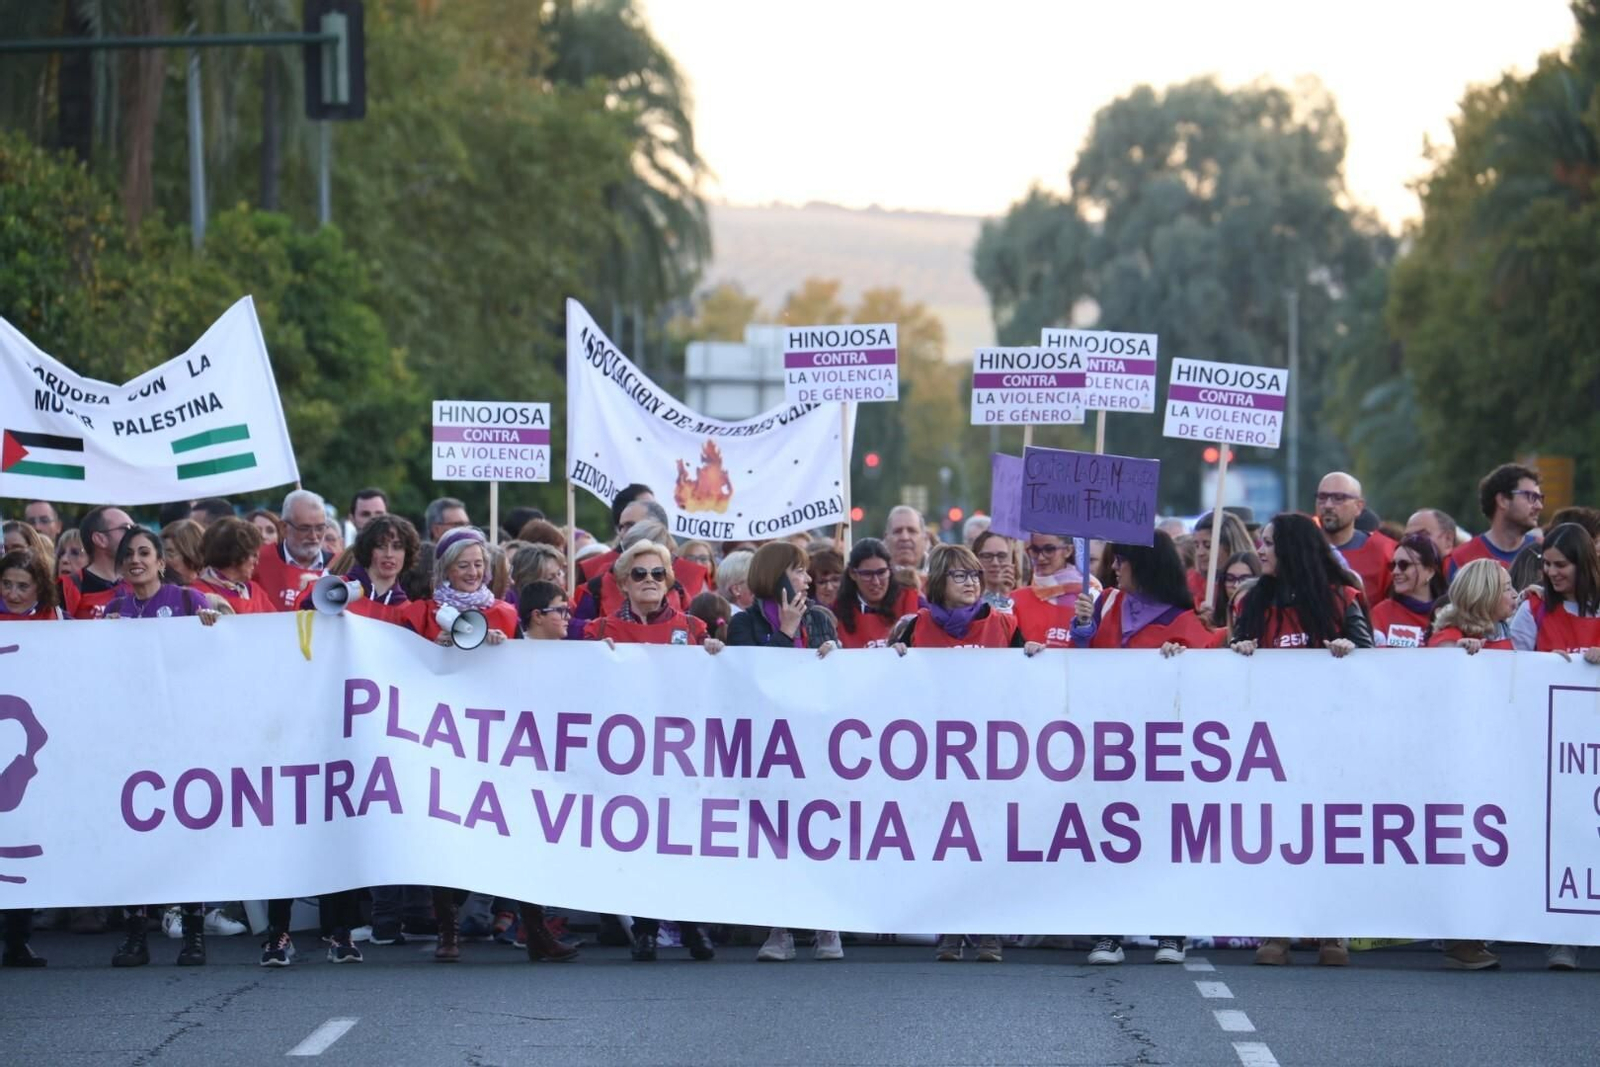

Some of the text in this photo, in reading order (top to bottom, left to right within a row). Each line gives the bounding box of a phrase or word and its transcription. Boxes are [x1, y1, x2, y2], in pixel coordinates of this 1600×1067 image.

[789, 329, 891, 349] HINOJOSA
[1047, 334, 1150, 356] HINOJOSA
[187, 354, 211, 378] LA
[813, 352, 868, 366] CONTRA
[979, 352, 1082, 370] HINOJOSA
[1087, 358, 1126, 372] NTRA
[789, 368, 893, 385] LA VIOLENCIA
[1002, 374, 1057, 387] CONTRA
[1177, 364, 1281, 391] HINOJOSA
[799, 386, 885, 402] DE GÉNERO
[977, 391, 1081, 405] LA VIOLENCIA
[1198, 389, 1254, 407] CONTRA
[113, 391, 223, 436] PALESTINA
[439, 405, 545, 425] HINOJOSA
[985, 407, 1072, 422] DE GÉNERO
[1171, 404, 1278, 427] LA VIOLENCIA
[462, 429, 520, 442] CONTRA
[1178, 423, 1266, 445] DE GÉNERO
[437, 446, 545, 461] LA VIOLENCIA
[446, 463, 536, 479] DE GÉNERO
[676, 495, 844, 540] DUQUE (CORDOBA)
[344, 679, 1287, 783] PLATAFORMA CORDOBESA
[120, 756, 1508, 867] CONTRA LA VIOLENCIA A LAS MUJERES
